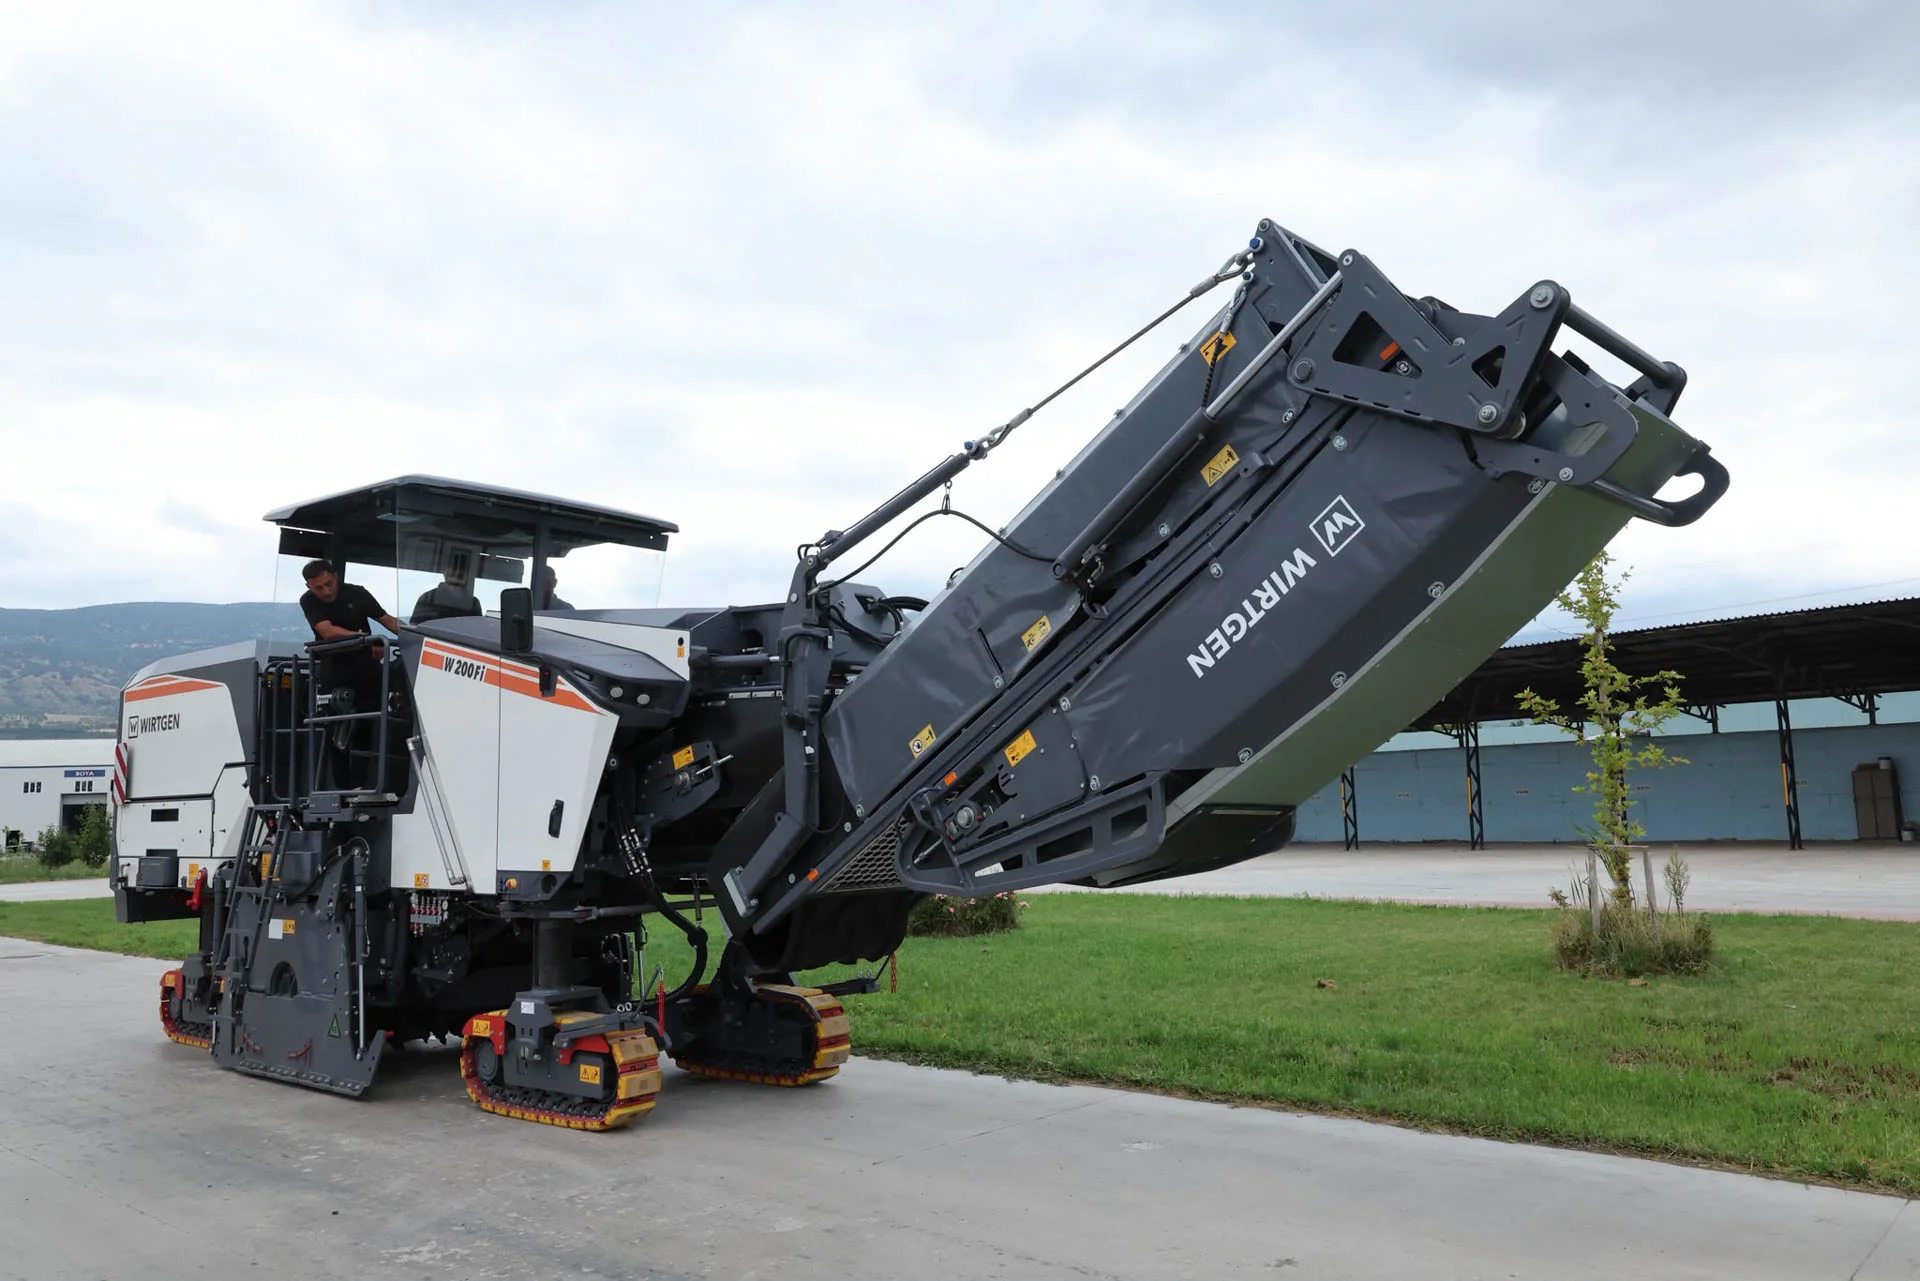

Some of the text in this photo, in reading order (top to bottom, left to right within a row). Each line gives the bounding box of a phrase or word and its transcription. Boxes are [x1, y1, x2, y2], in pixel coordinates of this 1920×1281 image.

[1186, 547, 1317, 679] WIRTGEN
[444, 656, 455, 672] W
[140, 713, 180, 733] WIRTGEN
